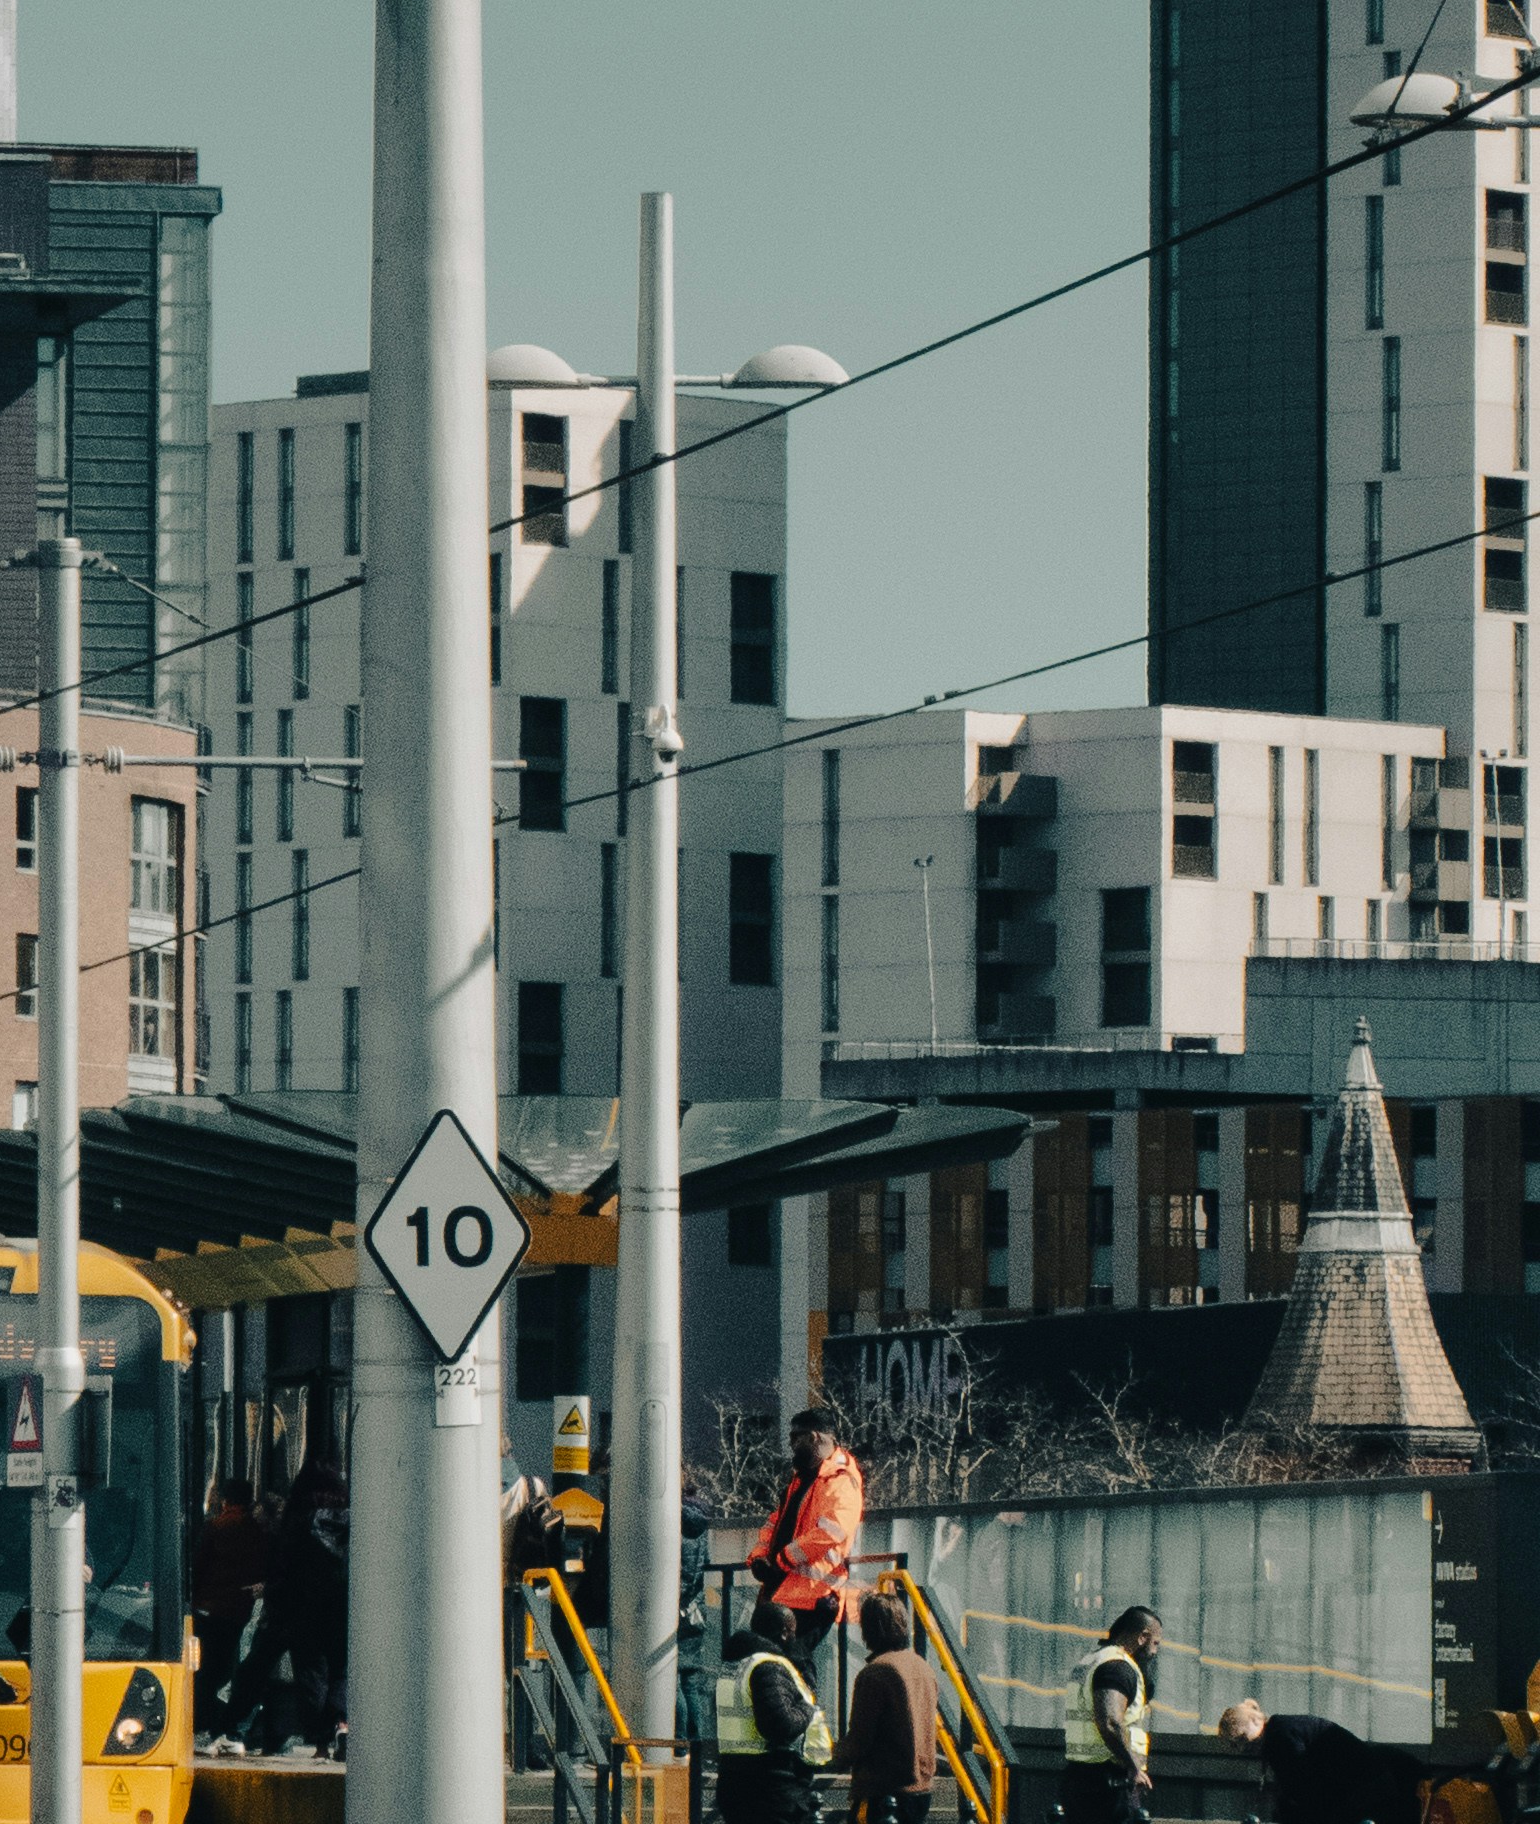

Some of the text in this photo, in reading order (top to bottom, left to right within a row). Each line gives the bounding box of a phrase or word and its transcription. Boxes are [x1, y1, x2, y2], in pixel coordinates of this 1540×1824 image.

[406, 1205, 494, 1268] 10
[439, 1368, 477, 1386] 222
[861, 1338, 964, 1442] HOME
